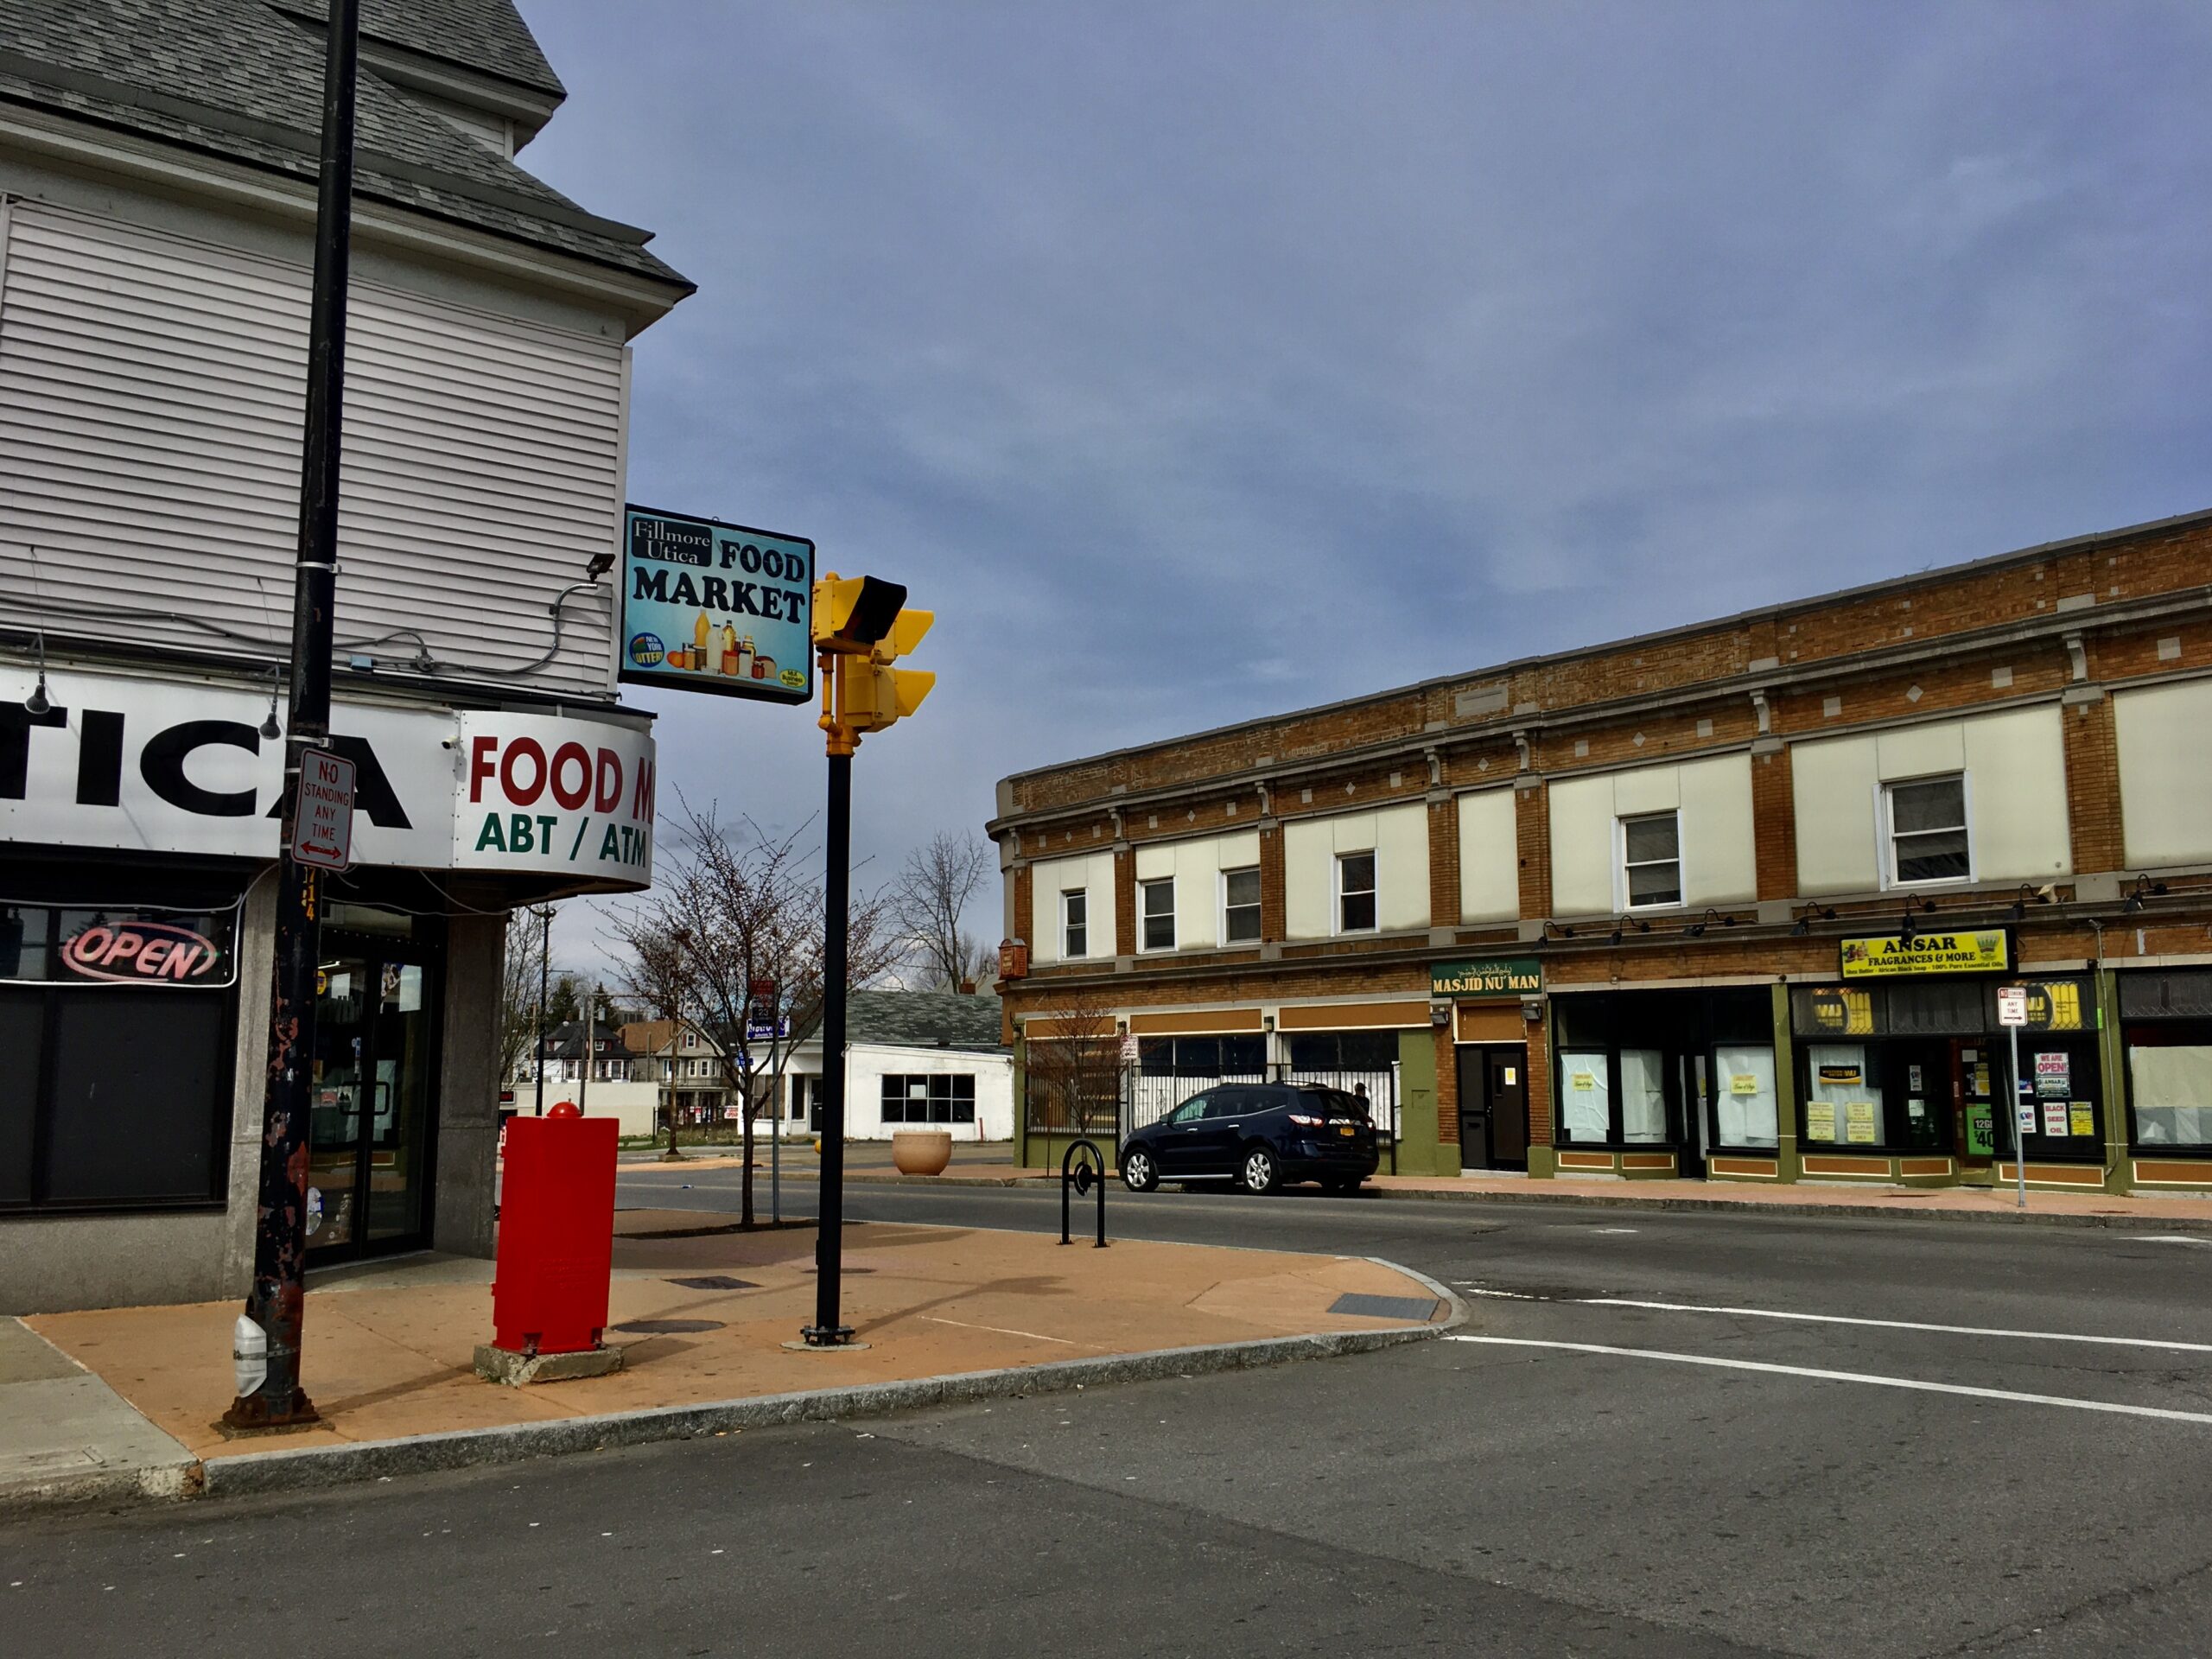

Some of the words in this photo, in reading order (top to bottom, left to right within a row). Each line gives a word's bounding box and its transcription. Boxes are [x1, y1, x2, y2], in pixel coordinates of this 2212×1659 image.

[633, 520, 711, 547] Fillmore
[646, 539, 699, 564] Utica
[719, 539, 805, 582] FOOD
[632, 566, 806, 624] MARKET
[319, 760, 339, 784] NO
[469, 735, 624, 814] FOOD
[304, 782, 349, 806] STANDING
[315, 804, 336, 821] ANY
[312, 823, 336, 842] TIME
[474, 812, 558, 855] ABT
[599, 823, 646, 868] ATM
[73, 926, 203, 980] OPEN
[1883, 937, 1958, 954] ANSAR
[1868, 954, 1933, 966] FRAGRANCES
[1946, 951, 1976, 962] MORE
[1433, 977, 1483, 993] MASJID
[2037, 1062, 2067, 1072] OPEN!
